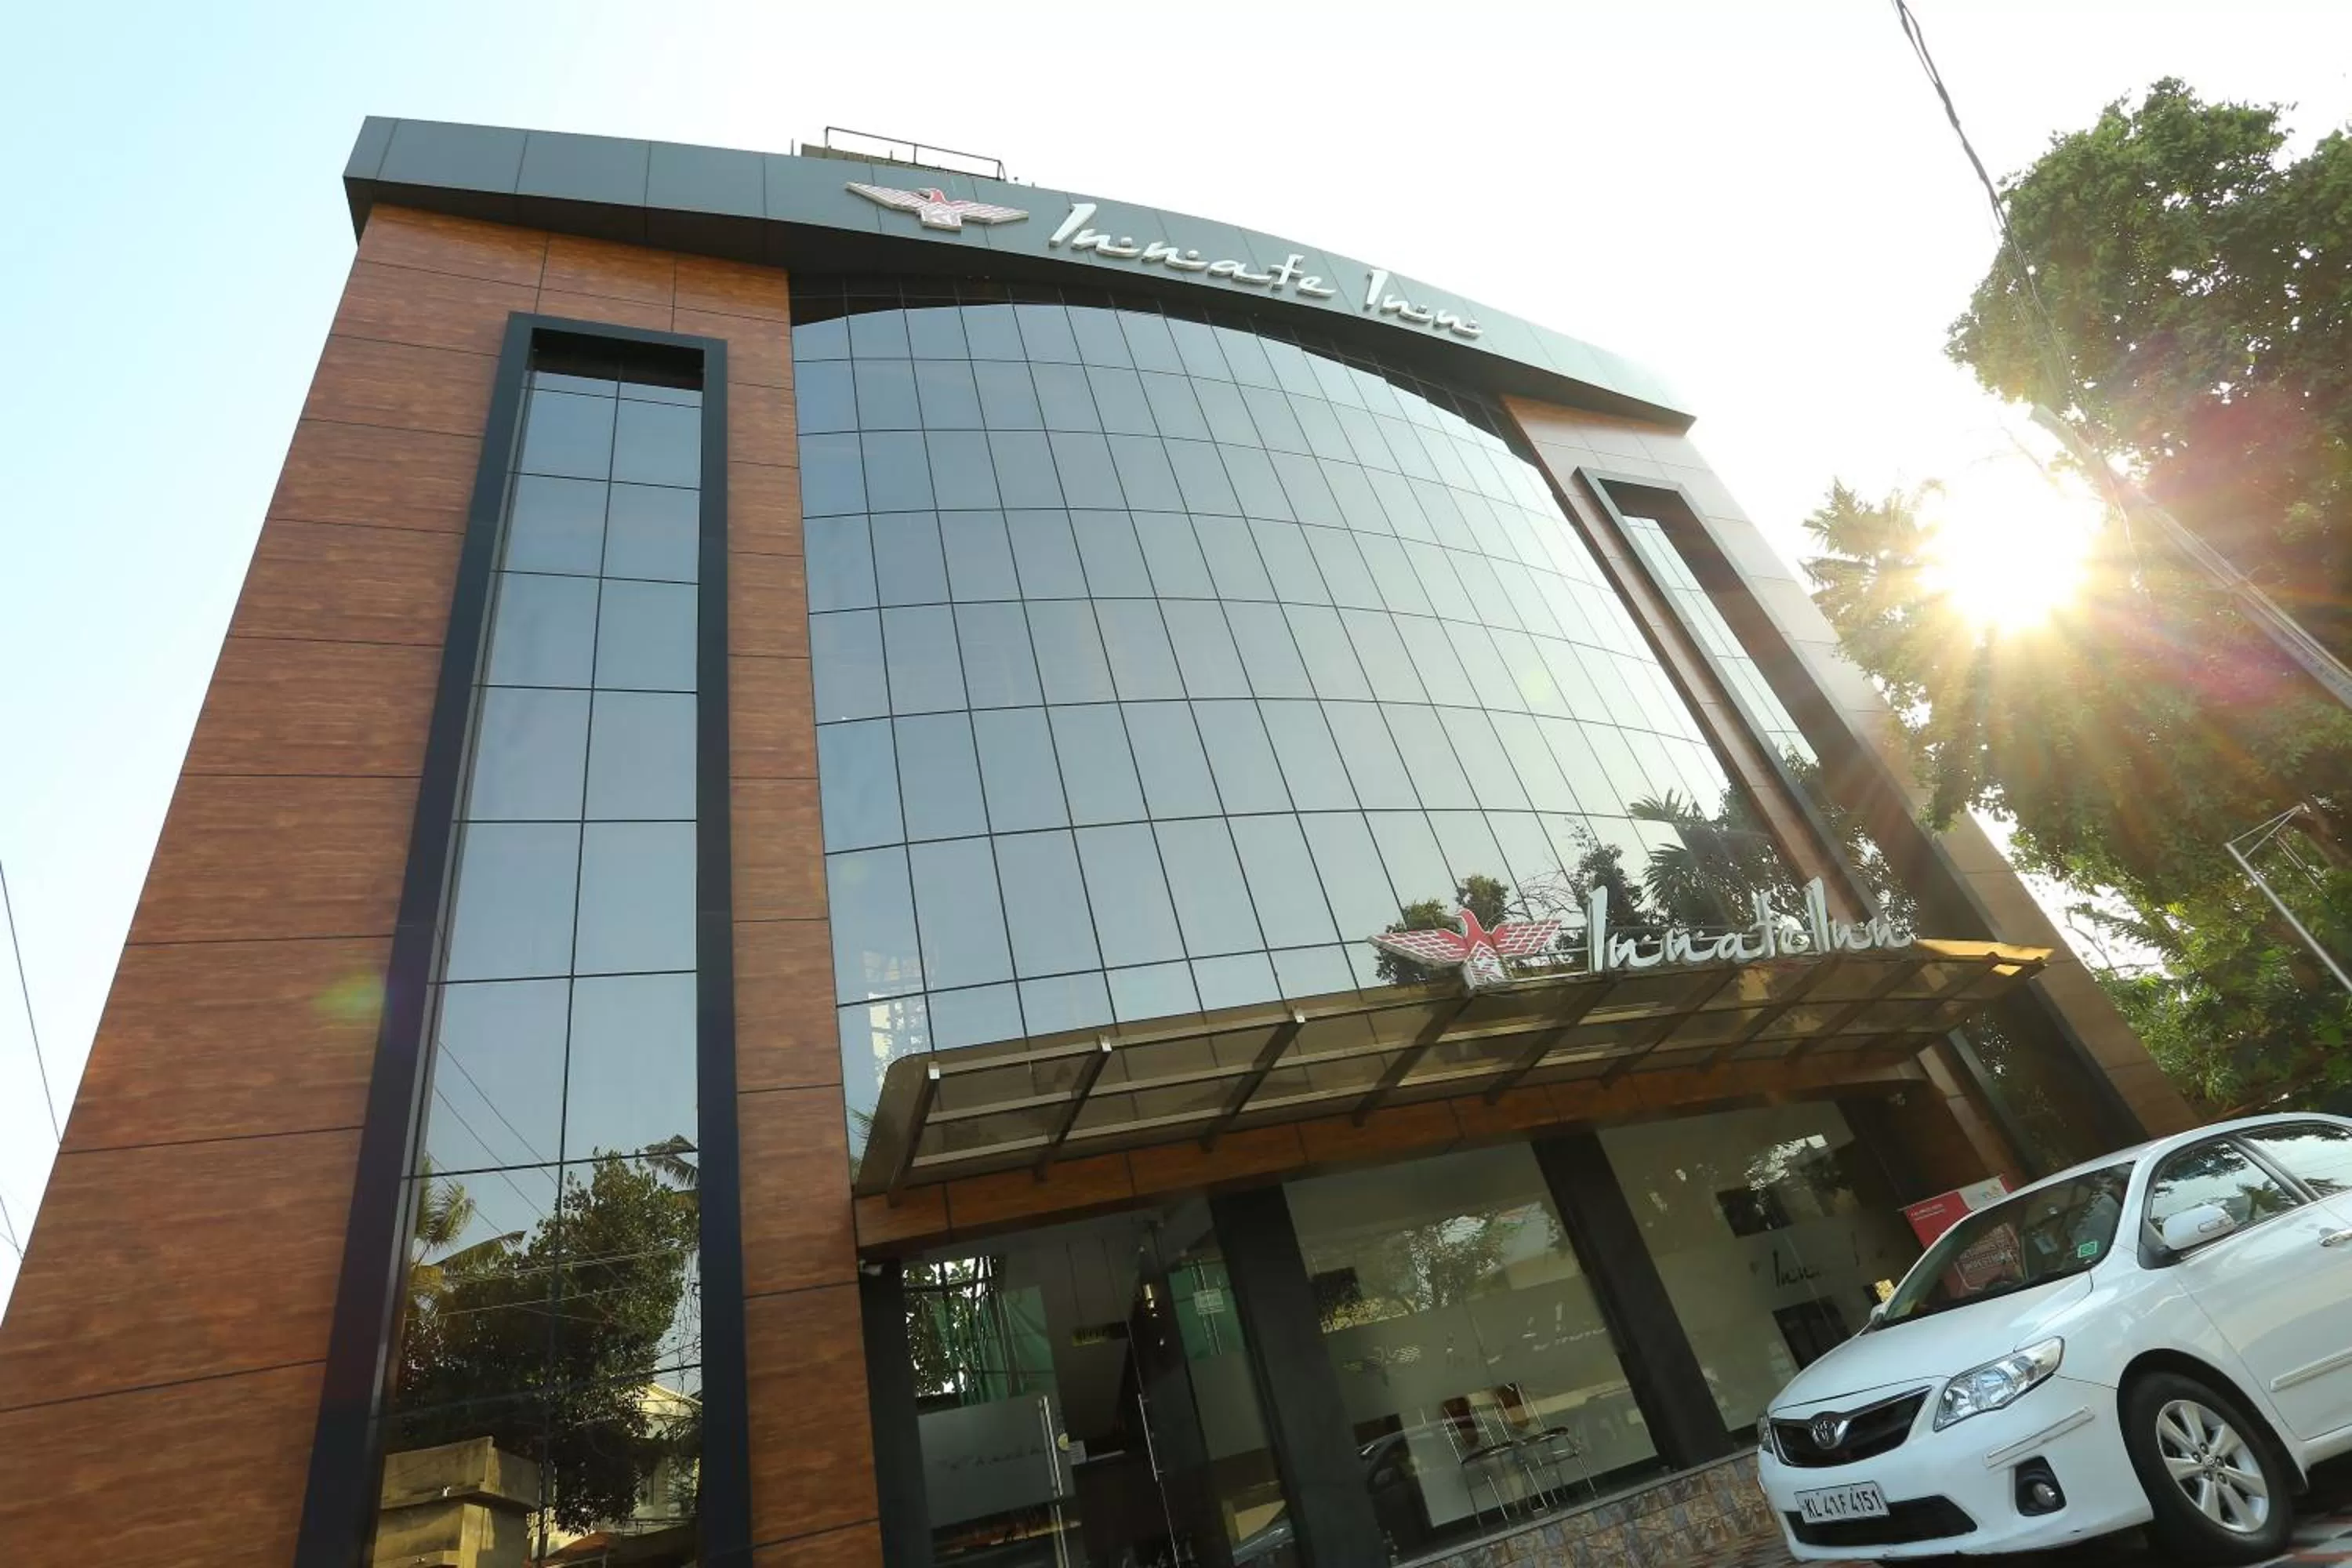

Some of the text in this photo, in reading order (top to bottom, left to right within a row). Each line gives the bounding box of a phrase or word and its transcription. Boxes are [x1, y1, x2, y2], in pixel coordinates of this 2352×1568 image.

[1049, 203, 1483, 338] Innate Inn
[1588, 877, 1916, 973] Innate Inn
